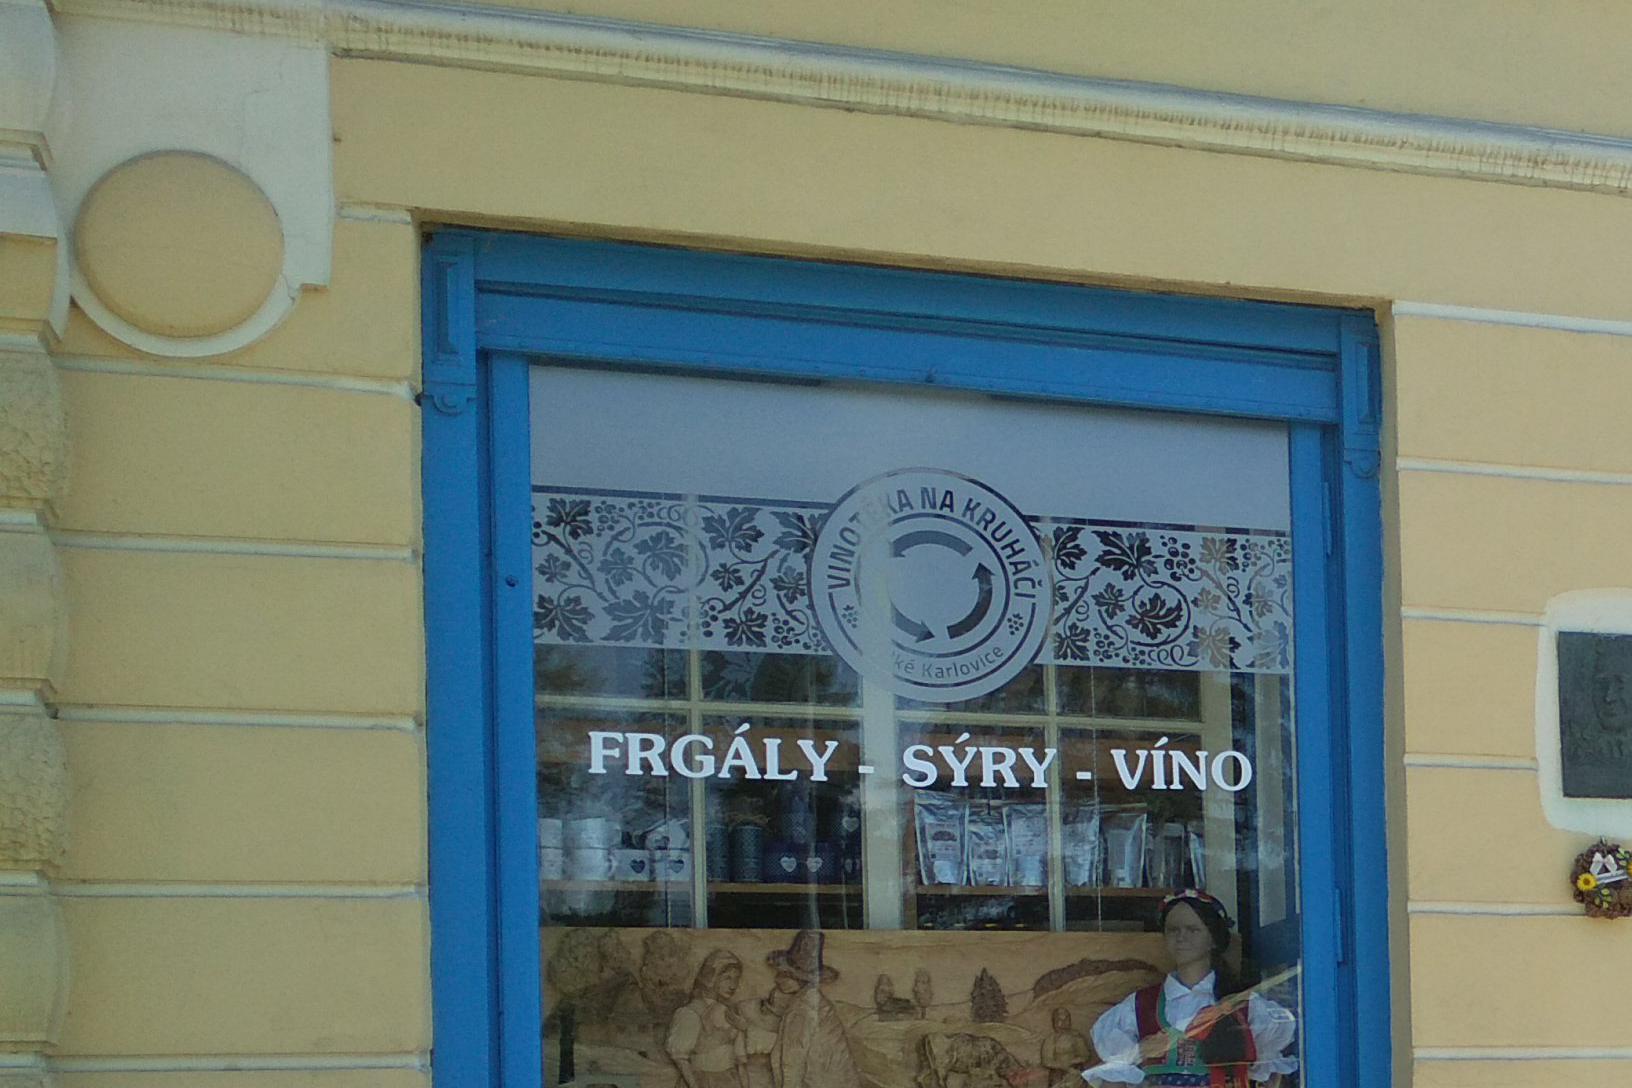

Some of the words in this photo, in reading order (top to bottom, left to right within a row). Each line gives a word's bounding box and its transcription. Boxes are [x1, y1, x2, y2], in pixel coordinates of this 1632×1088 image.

[827, 488, 914, 591] VINOTKA
[920, 486, 955, 513] NA
[961, 496, 1043, 600] KRUHÁČI
[921, 645, 1004, 680] Karlovice
[588, 722, 839, 782] FRGÁLY
[902, 732, 1057, 788] SÝRY
[1110, 736, 1253, 792] VÍNO
